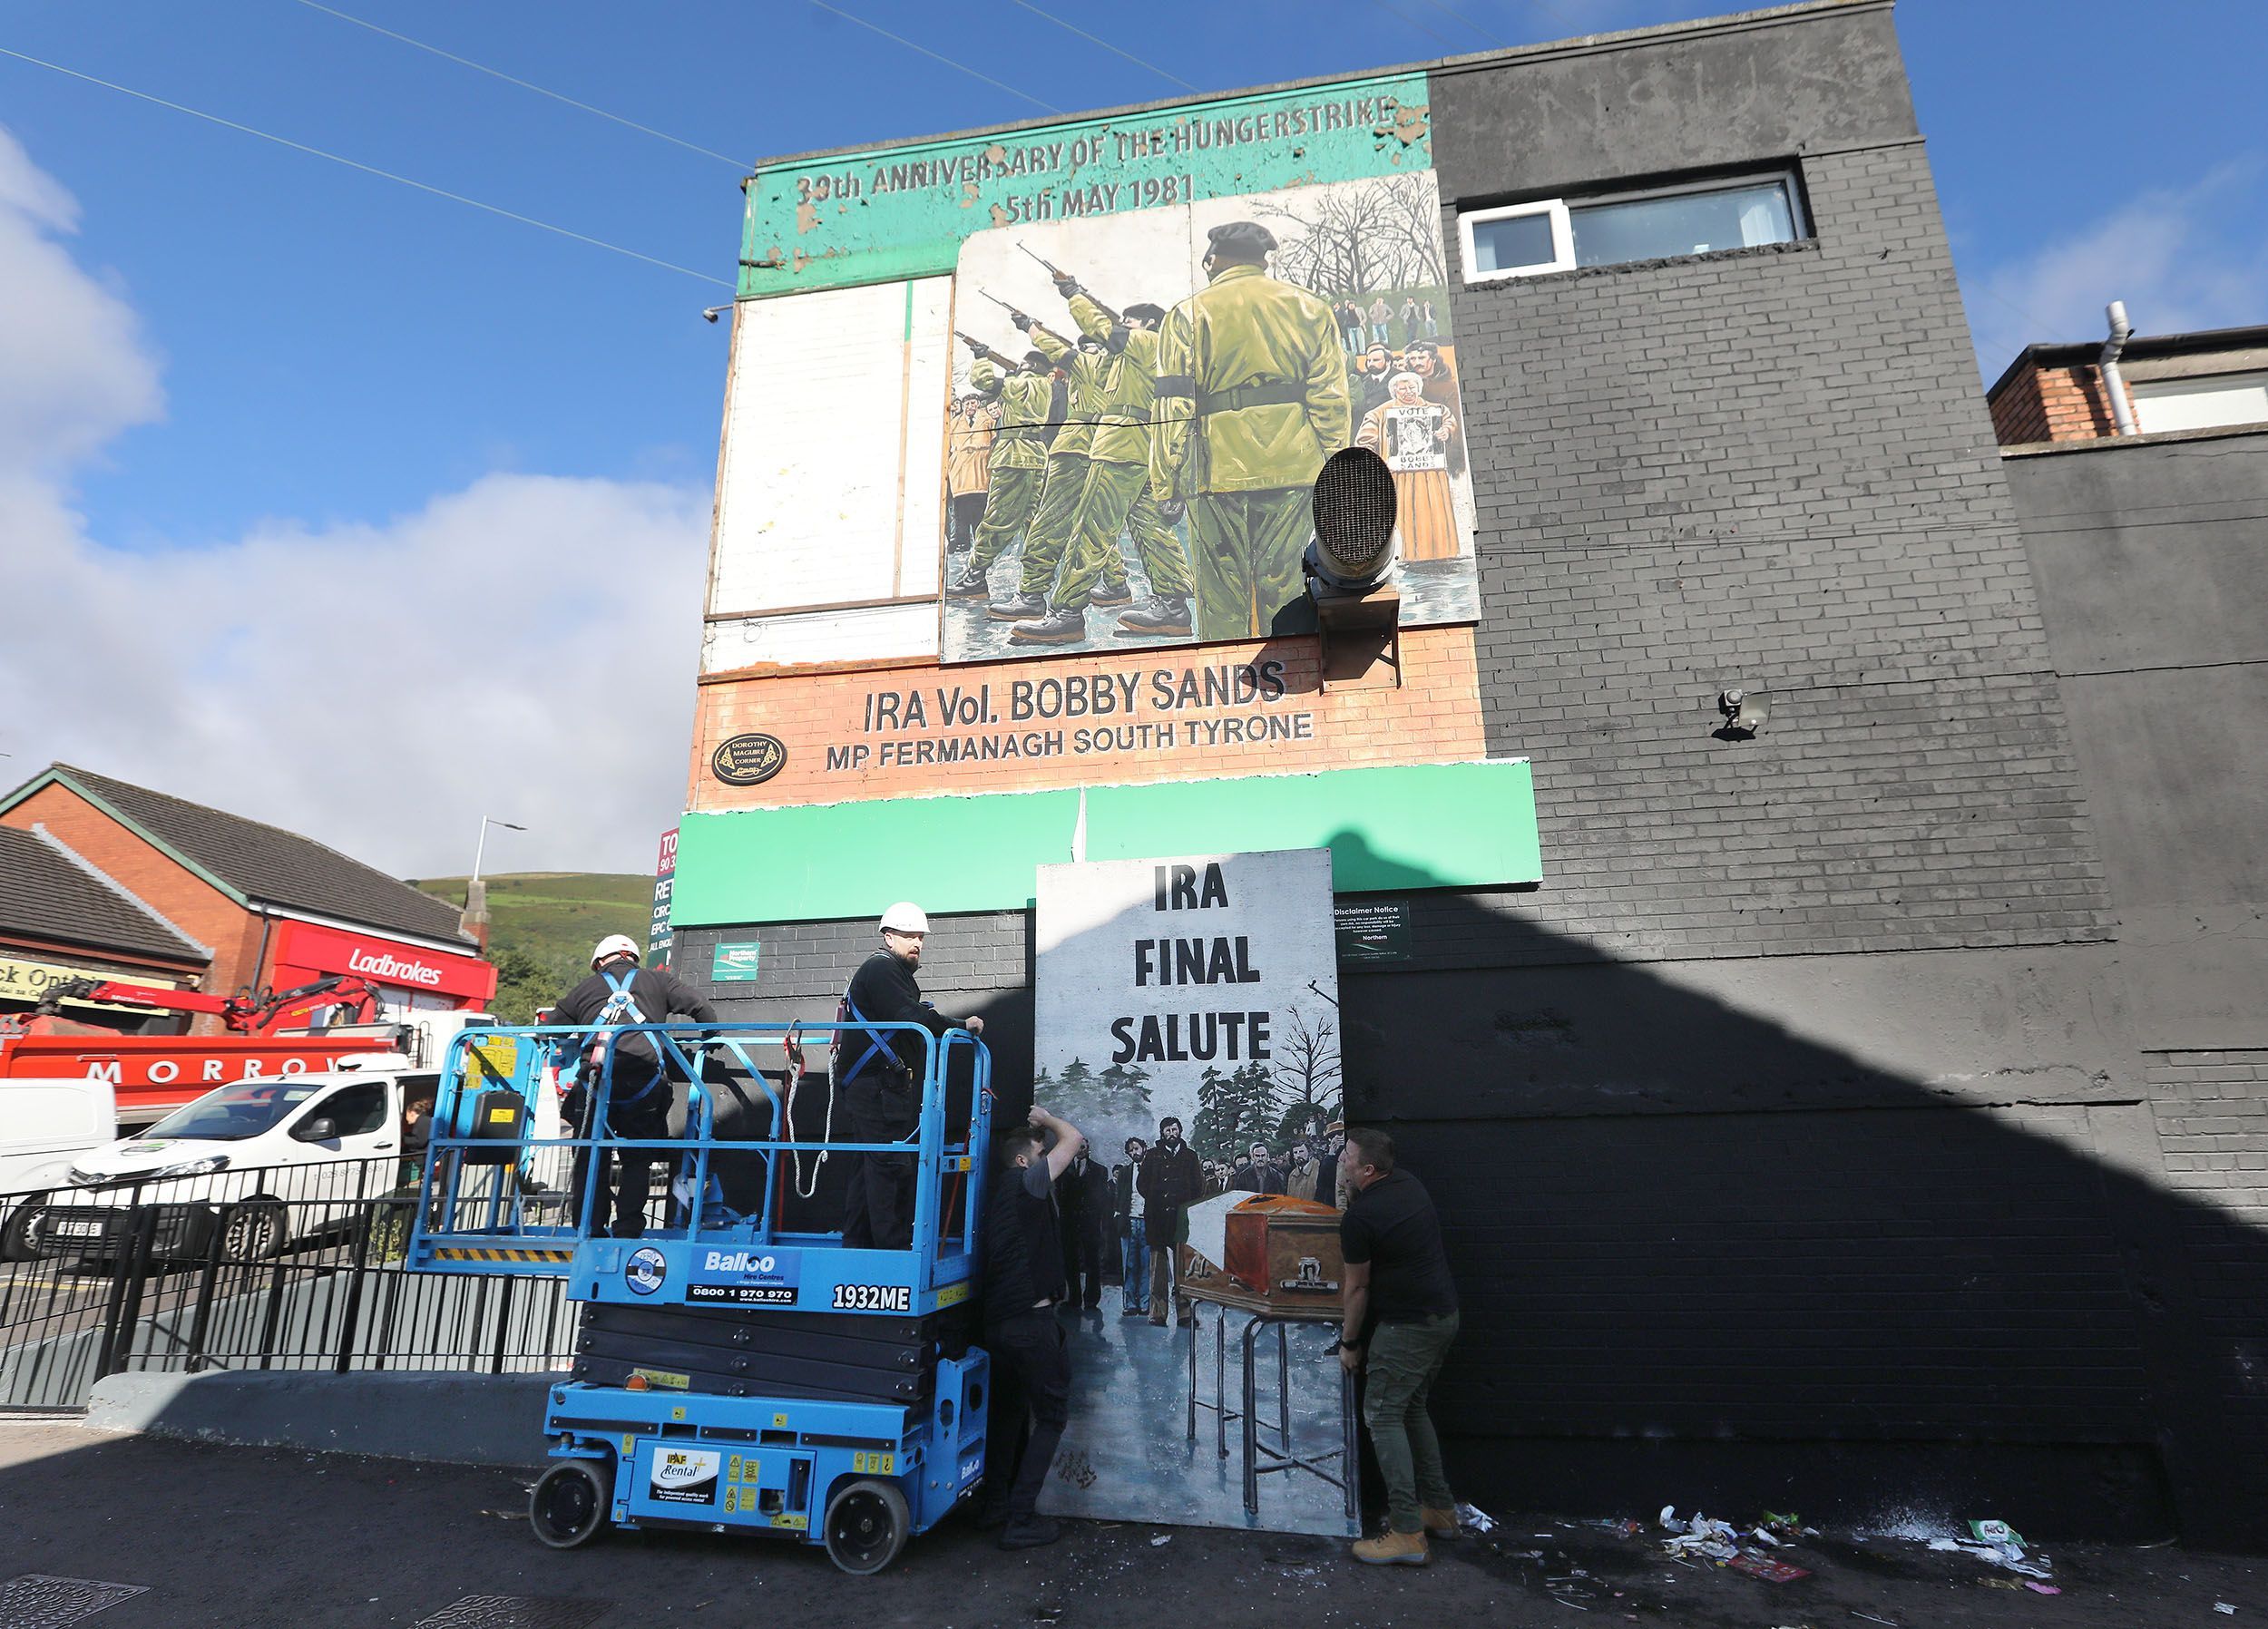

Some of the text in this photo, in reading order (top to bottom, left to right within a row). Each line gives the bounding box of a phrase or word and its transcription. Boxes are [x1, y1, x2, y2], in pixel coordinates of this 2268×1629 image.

[871, 141, 1064, 195] ANNIVERSARY
[1071, 135, 1106, 167] OF
[1115, 131, 1167, 161] THE
[1176, 95, 1393, 154] HUNGERSTRIKE
[1006, 174, 1194, 224] 5th MAY 1981
[1399, 407, 1429, 415] VOTE
[865, 660, 1286, 732] IRA Vol. BOBBY SANDS
[826, 713, 1313, 771] MP FERMANAGH SOUTH TYRONE
[1155, 863, 1228, 912] IRA
[348, 948, 443, 986] Ladbrokes
[1135, 936, 1261, 987] FINAL
[1110, 1011, 1271, 1064] SALUTE
[704, 1251, 776, 1273] Balloo
[693, 1288, 792, 1299] 0800 1 970 970
[834, 1285, 910, 1311] 1932ME
[660, 1465, 698, 1479] Rental
[667, 1453, 687, 1464] IPAF
